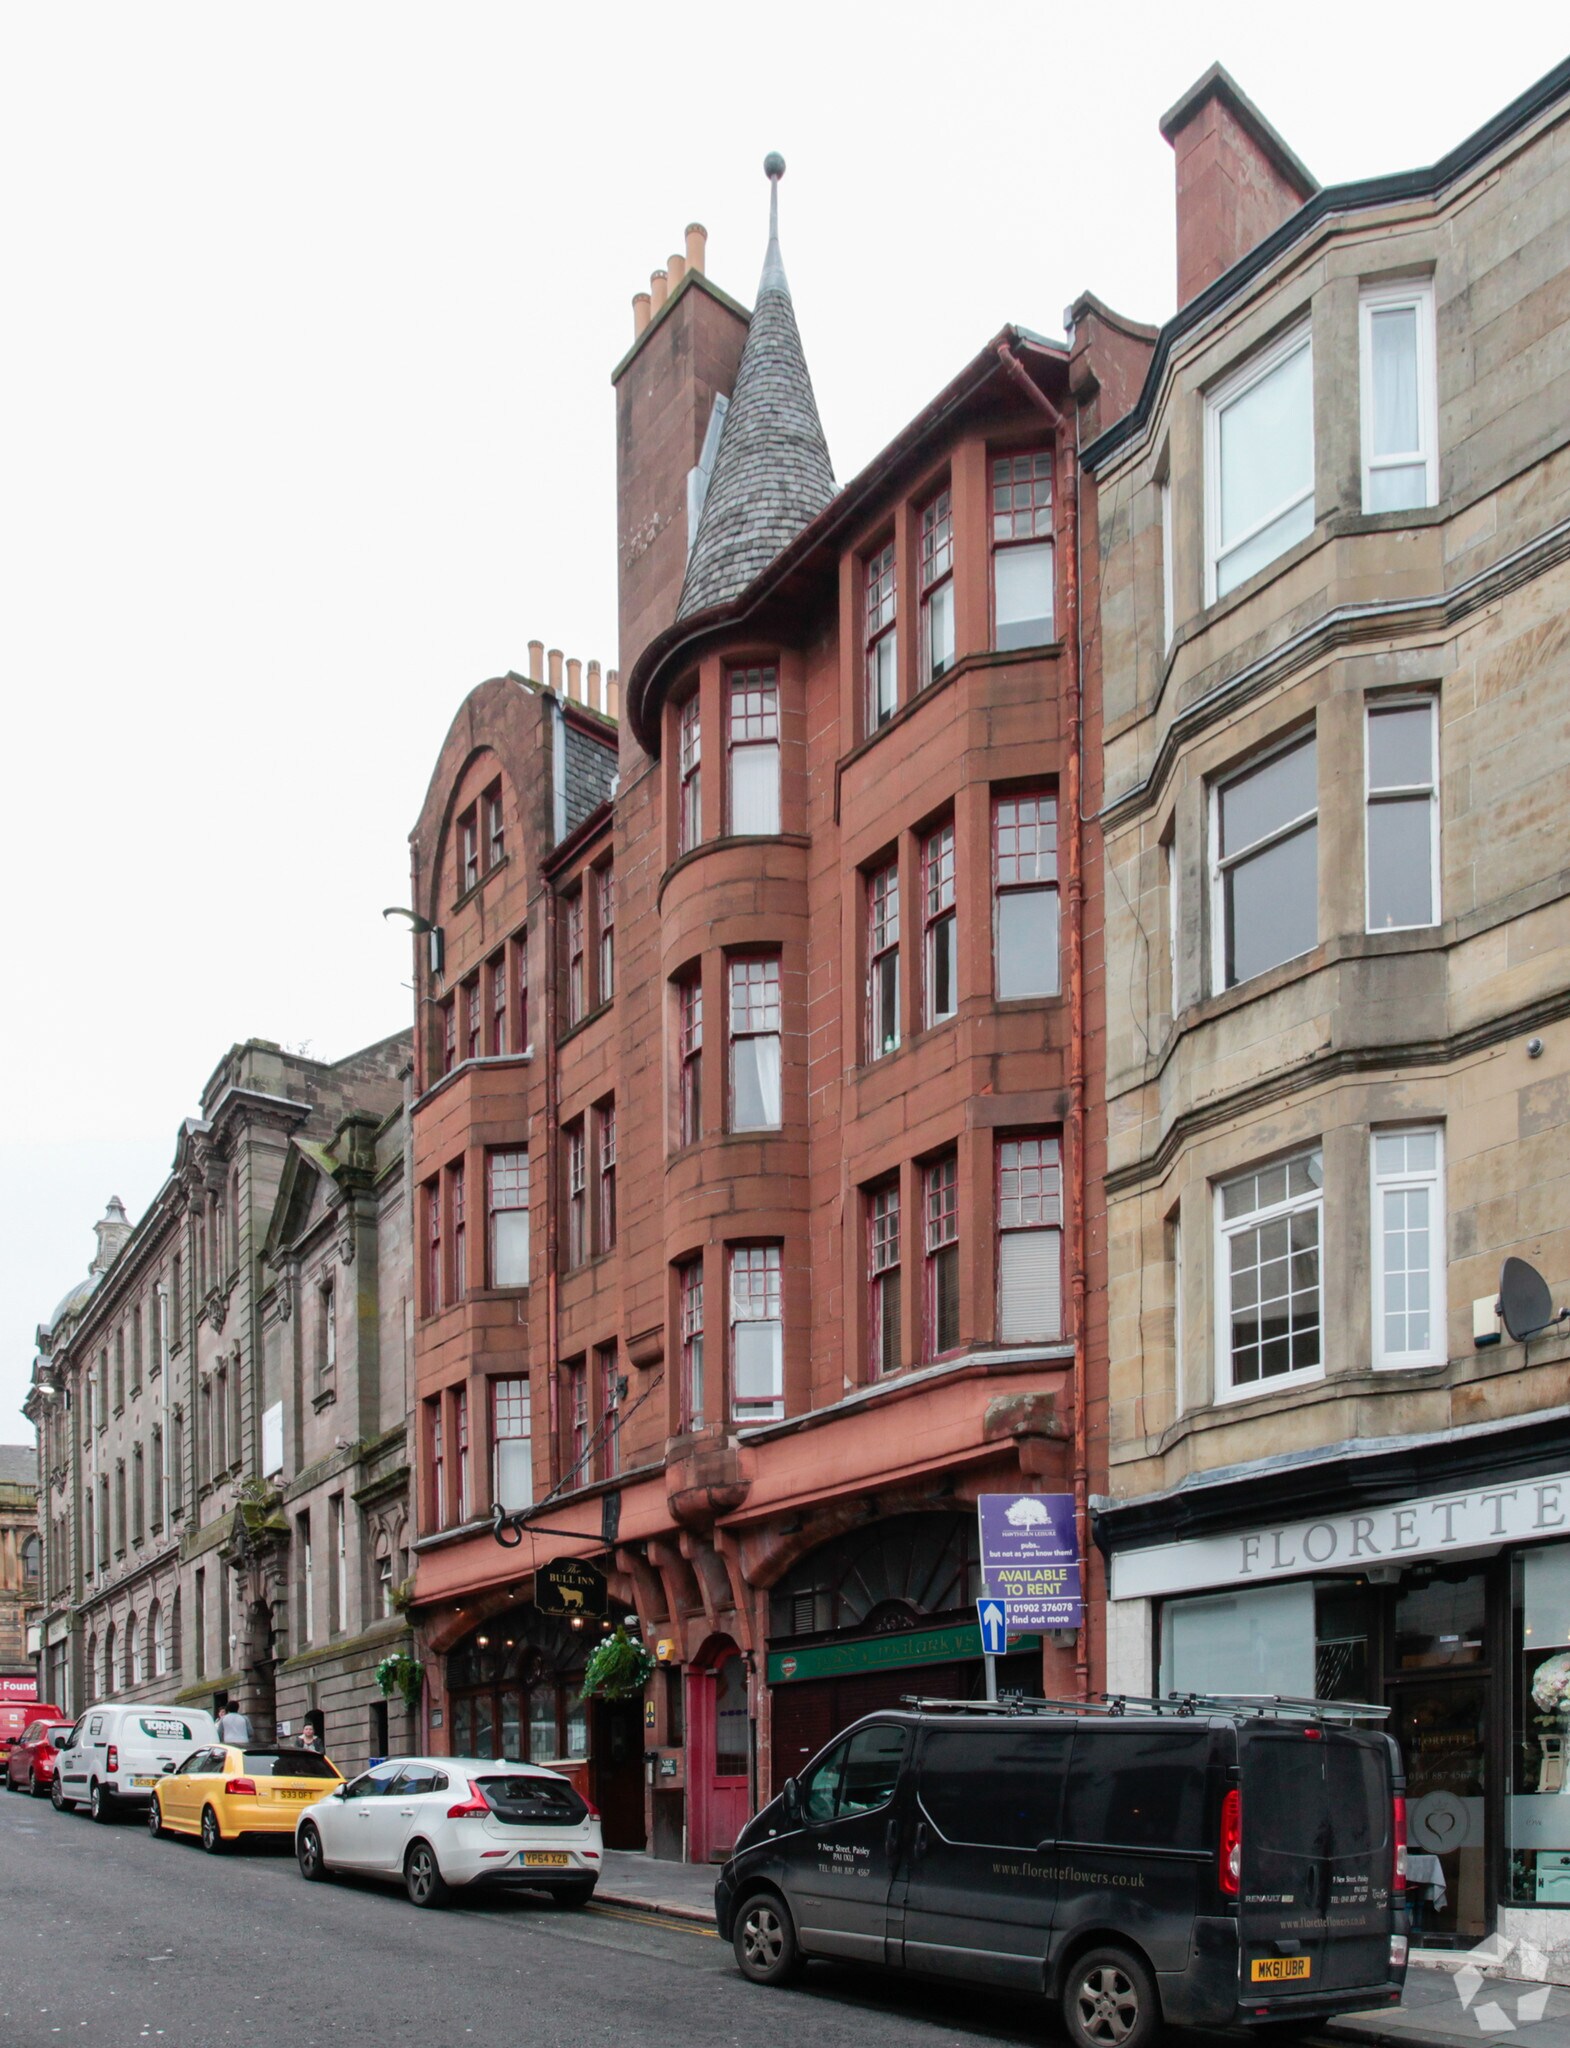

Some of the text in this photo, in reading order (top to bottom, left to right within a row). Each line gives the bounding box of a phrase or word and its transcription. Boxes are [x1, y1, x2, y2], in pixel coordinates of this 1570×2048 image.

[1239, 1483, 1565, 1573] FLORETTE
[1023, 1551, 1035, 1559] you
[566, 1563, 581, 1574] The
[549, 1573, 595, 1585] BULL INN
[998, 1569, 1067, 1582] AVAILABLE
[1005, 1583, 1062, 1596] TO RENT
[1013, 1604, 1039, 1613] 01902
[1042, 1603, 1073, 1612] 376078
[1012, 1616, 1030, 1624] find
[1032, 1616, 1045, 1624] out
[1047, 1615, 1069, 1623] more
[4, 1681, 37, 1690] Found
[144, 1720, 184, 1731] TURNER
[823, 1843, 833, 1851] New
[853, 1846, 870, 1858] Paisley
[526, 1853, 549, 1864] YP64
[993, 1862, 1145, 1887] www.floretteflowers.co.uk
[1258, 1960, 1304, 1978] MK61 UBR
